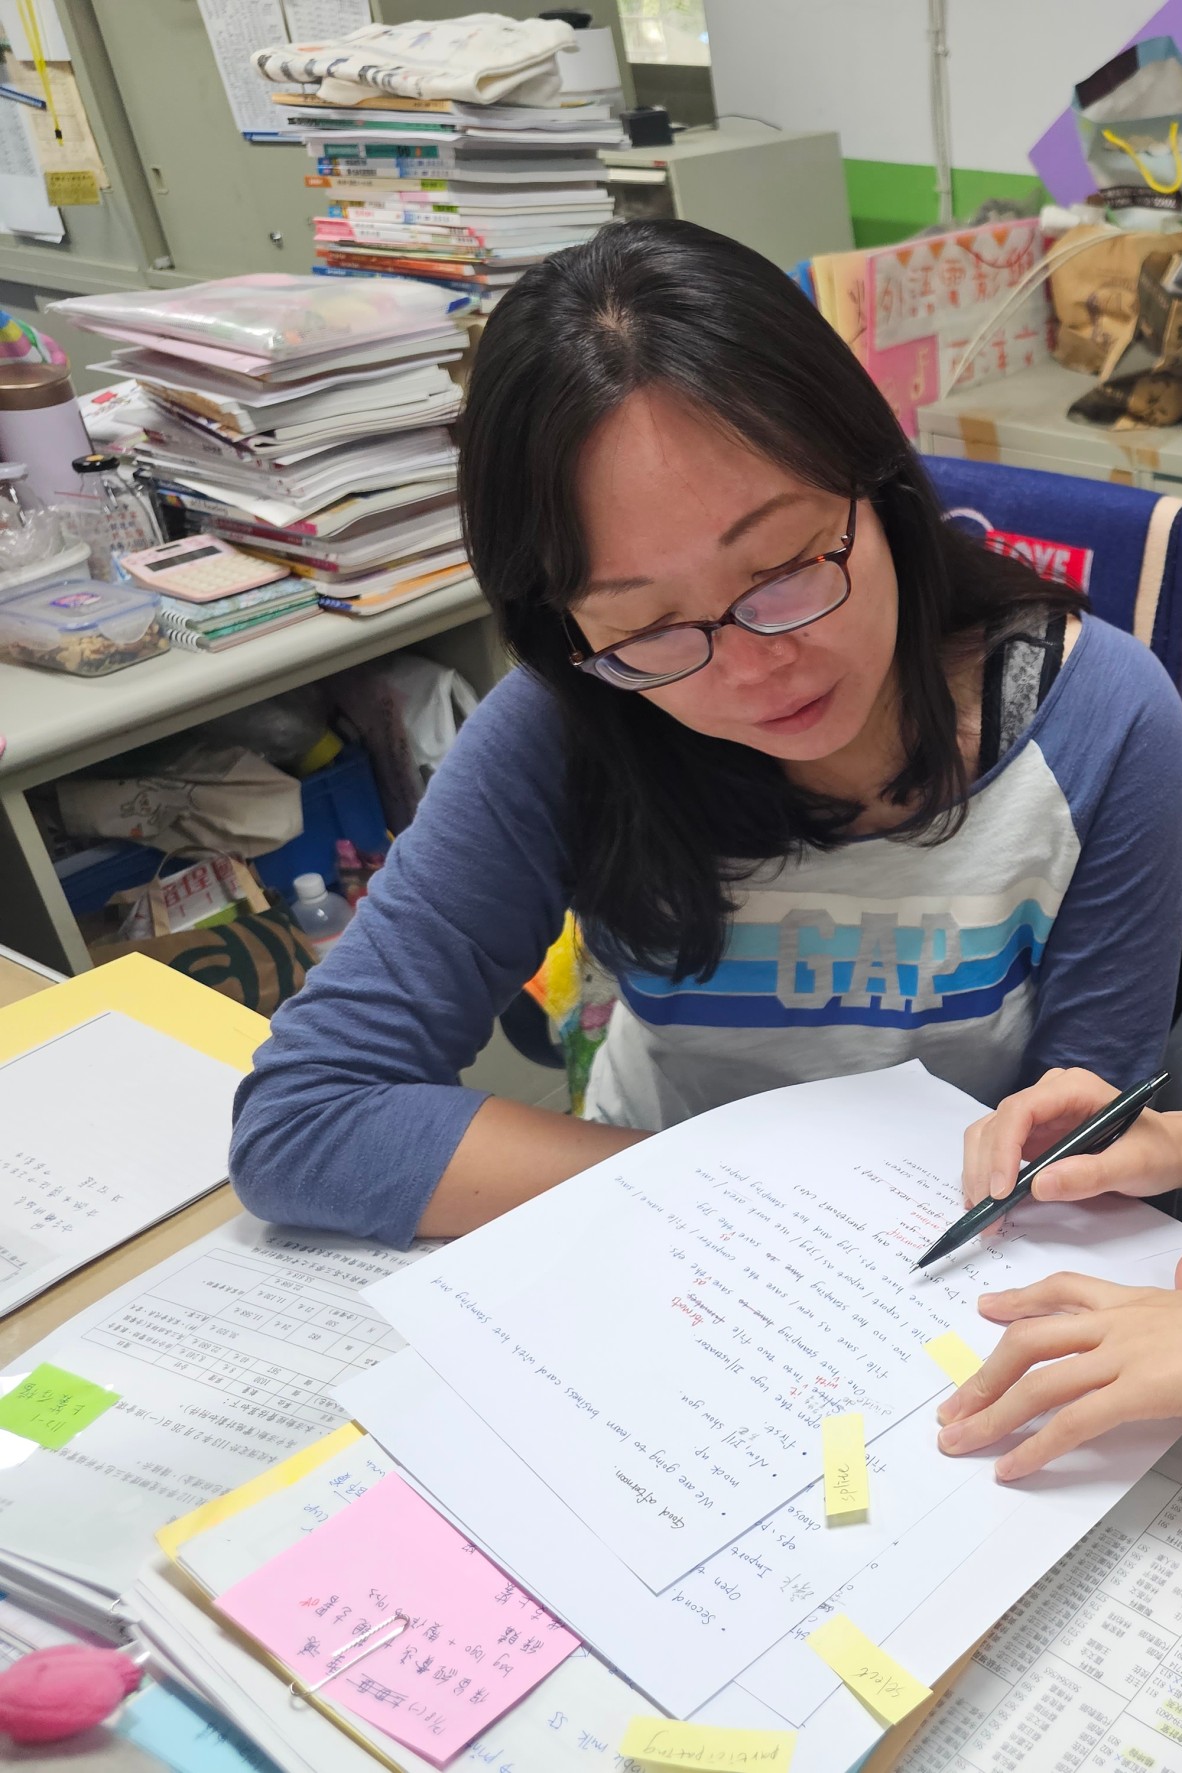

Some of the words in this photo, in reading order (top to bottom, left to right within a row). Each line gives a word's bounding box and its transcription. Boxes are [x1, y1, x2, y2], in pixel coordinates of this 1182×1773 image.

[777, 908, 961, 1013] GAP
[614, 1175, 634, 1190] save
[695, 1168, 715, 1181] save
[723, 1189, 745, 1203] area
[749, 1181, 786, 1208] stamping
[667, 1214, 687, 1229] file
[747, 1207, 770, 1221] work
[792, 1211, 809, 1223] hot
[718, 1217, 733, 1230] the
[812, 1225, 832, 1238] and
[738, 1232, 761, 1247] save
[871, 1231, 892, 1246] any
[690, 1262, 706, 1276] the
[743, 1266, 759, 1279] the
[430, 1276, 452, 1291] and
[712, 1279, 732, 1294] save
[837, 1271, 864, 1290] export
[881, 1275, 903, 1294] have
[765, 1282, 788, 1297] save
[809, 1280, 845, 1310] stamping
[944, 1286, 959, 1300] Do
[455, 1291, 492, 1323] stamping
[872, 1298, 899, 1319] export
[909, 1294, 923, 1307] we
[817, 1321, 831, 1332] as
[851, 1314, 868, 1327] hot
[492, 1327, 510, 1343] hot
[732, 1326, 752, 1344] file
[777, 1325, 818, 1357] stamping
[872, 1330, 886, 1341] no
[837, 1336, 859, 1351] save
[511, 1344, 535, 1364] with
[756, 1346, 775, 1362] two
[534, 1366, 561, 1385] card
[782, 1364, 803, 1382] into
[819, 1361, 839, 1377] hot
[866, 1361, 888, 1378] file
[812, 1374, 839, 1390] with
[774, 1394, 792, 1411] the
[701, 1412, 724, 1429] show
[797, 1411, 820, 1428] open
[606, 1420, 631, 1442] learn
[633, 1441, 646, 1452] to
[648, 1449, 680, 1472] going
[678, 1475, 695, 1489] are
[710, 1465, 739, 1487] mock
[614, 1465, 656, 1504] afternoon.
[694, 1490, 713, 1508] We
[657, 1506, 684, 1528] Good
[787, 1505, 820, 1530] choose
[730, 1538, 772, 1578] Import
[714, 1576, 741, 1600] Open
[577, 1730, 608, 1752] milk
